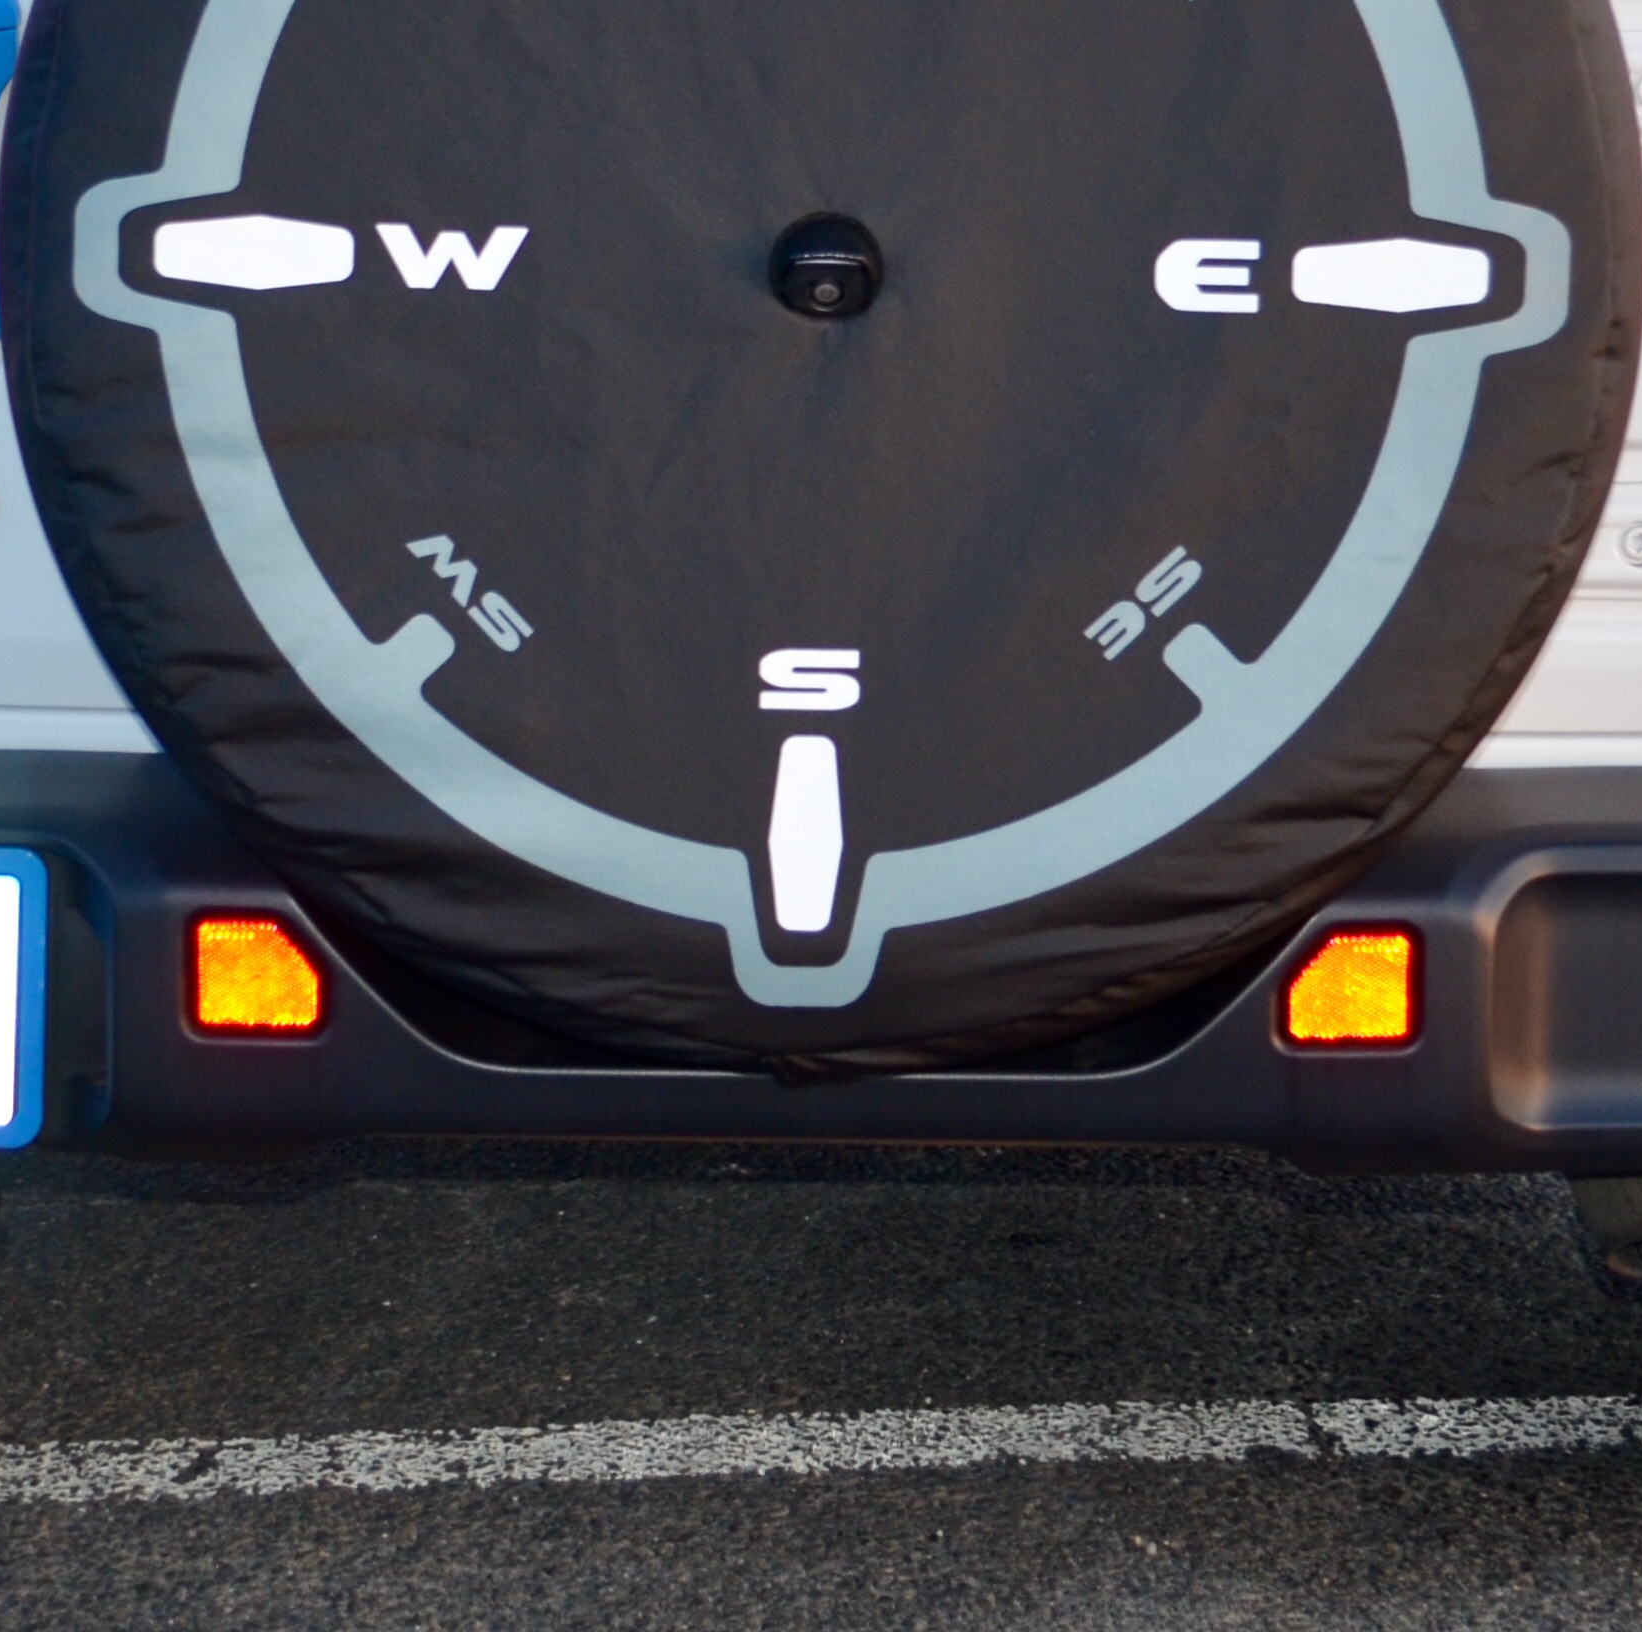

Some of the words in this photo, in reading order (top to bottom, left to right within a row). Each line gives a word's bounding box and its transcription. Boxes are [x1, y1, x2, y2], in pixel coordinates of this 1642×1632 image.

[374, 222, 530, 291] W
[1153, 238, 1261, 314] E
[406, 533, 535, 652] SW
[1083, 544, 1203, 661] SE
[758, 647, 861, 712] S
